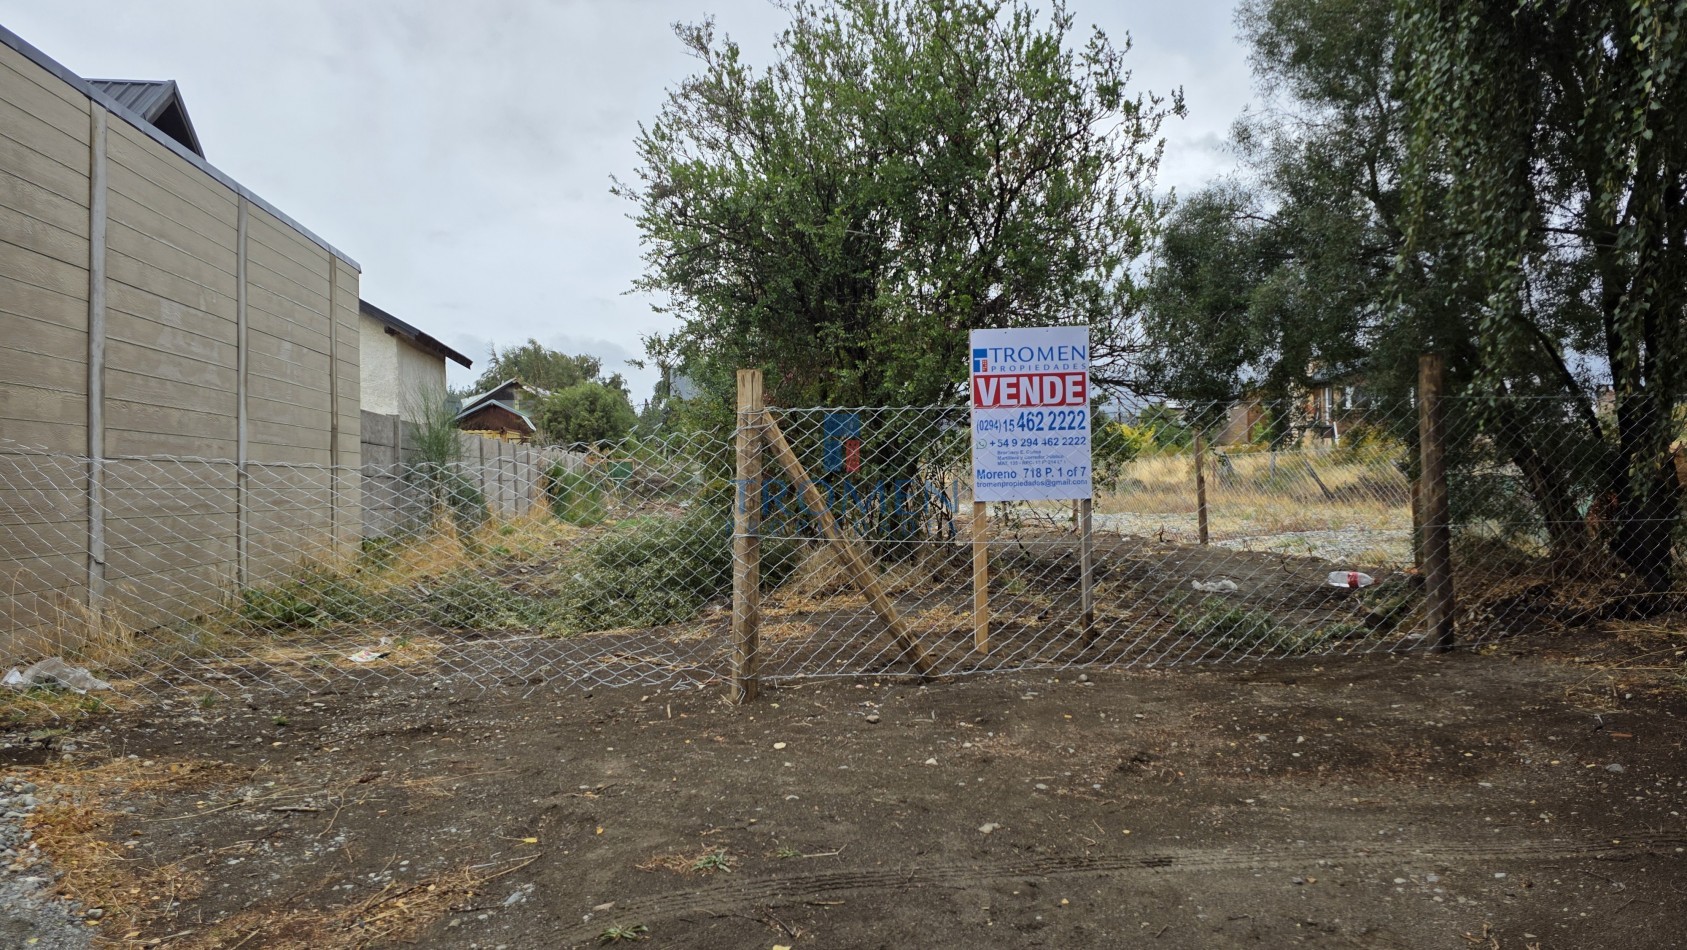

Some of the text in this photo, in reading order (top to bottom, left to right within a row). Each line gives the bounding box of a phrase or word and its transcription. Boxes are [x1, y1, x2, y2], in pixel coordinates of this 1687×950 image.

[988, 345, 1086, 363] TROMEN
[991, 362, 1087, 372] PROPIEDADES
[976, 374, 1084, 406] VENDE
[976, 410, 1086, 434] (0294) 15 462 2222
[1011, 438, 1017, 447] 9
[1020, 437, 1039, 447] 294
[1062, 436, 1086, 446] 2222
[976, 469, 1017, 479] Moreno
[1023, 468, 1042, 478] 718
[1045, 467, 1055, 478] P.
[1066, 466, 1078, 477] of
[1081, 466, 1087, 477] 7
